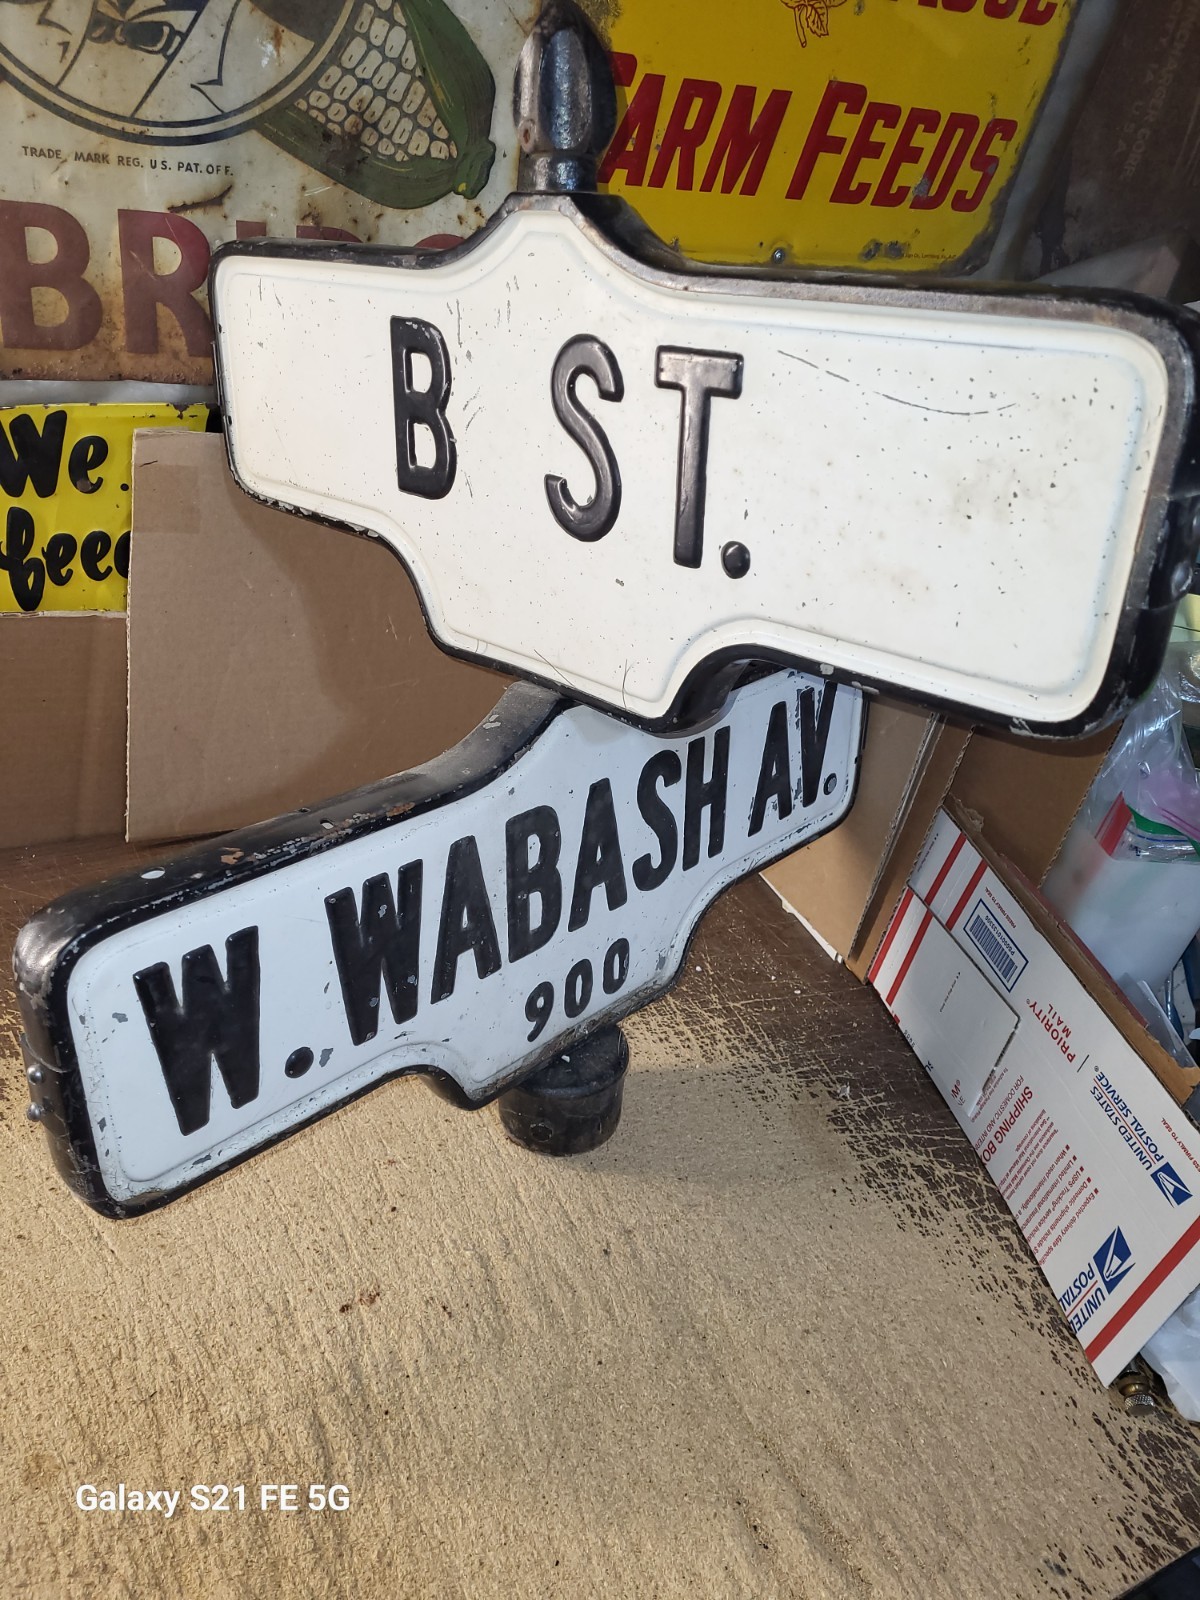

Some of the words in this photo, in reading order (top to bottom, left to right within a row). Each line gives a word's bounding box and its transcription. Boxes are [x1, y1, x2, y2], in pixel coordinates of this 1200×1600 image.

[22, 145, 62, 159] TRADE
[74, 151, 110, 165] MARK
[117, 155, 144, 169] REG.
[177, 161, 203, 174] PAT.
[390, 315, 458, 500] B
[544, 333, 751, 580] ST.
[132, 925, 315, 1137] W.
[323, 724, 731, 1046] WABASH
[747, 678, 838, 838] AV.
[524, 938, 631, 1043] 900
[1047, 1003, 1071, 1038] MAIL
[1013, 1074, 1024, 1090] FOR
[993, 1086, 1032, 1143] SHIPPING
[994, 1087, 1015, 1120] DOMESTIC
[1089, 1085, 1121, 1125] STATES
[986, 1117, 998, 1132] AND
[1161, 1117, 1172, 1132] SEAL
[1171, 1131, 1178, 1140] TO
[1118, 1125, 1152, 1170] UNITED
[1130, 1115, 1164, 1162] POSTAL
[1176, 1140, 1193, 1160] FIRMLY
[1054, 1149, 1066, 1165] When
[1057, 1159, 1073, 1180] Limited
[1045, 1163, 1055, 1178] used
[1067, 1170, 1080, 1187] USPS
[1036, 1178, 1060, 1210] international
[1068, 1180, 1087, 1206] Domestic
[1075, 1192, 1095, 1217] Expected
[1037, 1208, 1051, 1227] service
[1049, 1204, 1069, 1230] shipments
[1060, 1215, 1076, 1235] delivery
[1036, 1228, 1051, 1247] include
[1052, 1234, 1062, 1247] date
